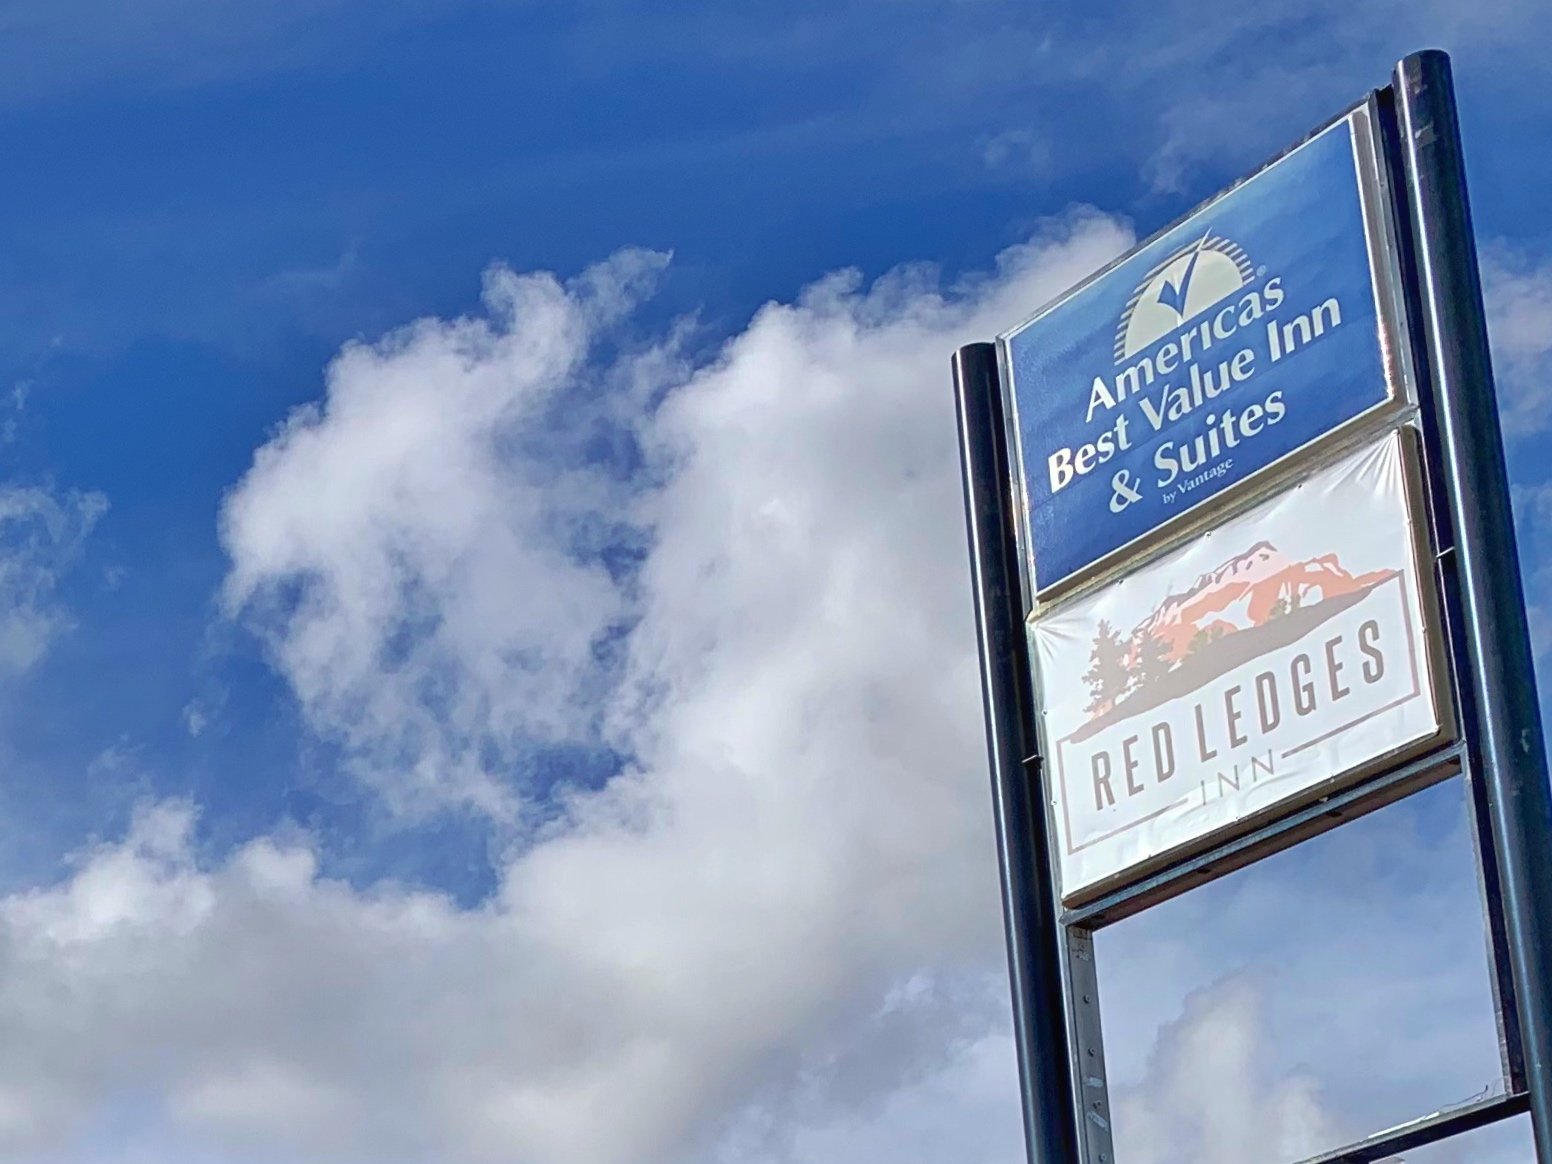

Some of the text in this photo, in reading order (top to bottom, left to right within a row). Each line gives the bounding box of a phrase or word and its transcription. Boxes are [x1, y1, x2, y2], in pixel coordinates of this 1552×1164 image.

[1048, 296, 1342, 493] Best Value Inn
[1085, 276, 1285, 423] Americas
[1108, 390, 1286, 513] & Suites
[1161, 457, 1234, 506] by Vantage
[1090, 618, 1385, 811] RED LEDGES
[1200, 748, 1276, 806] INN
